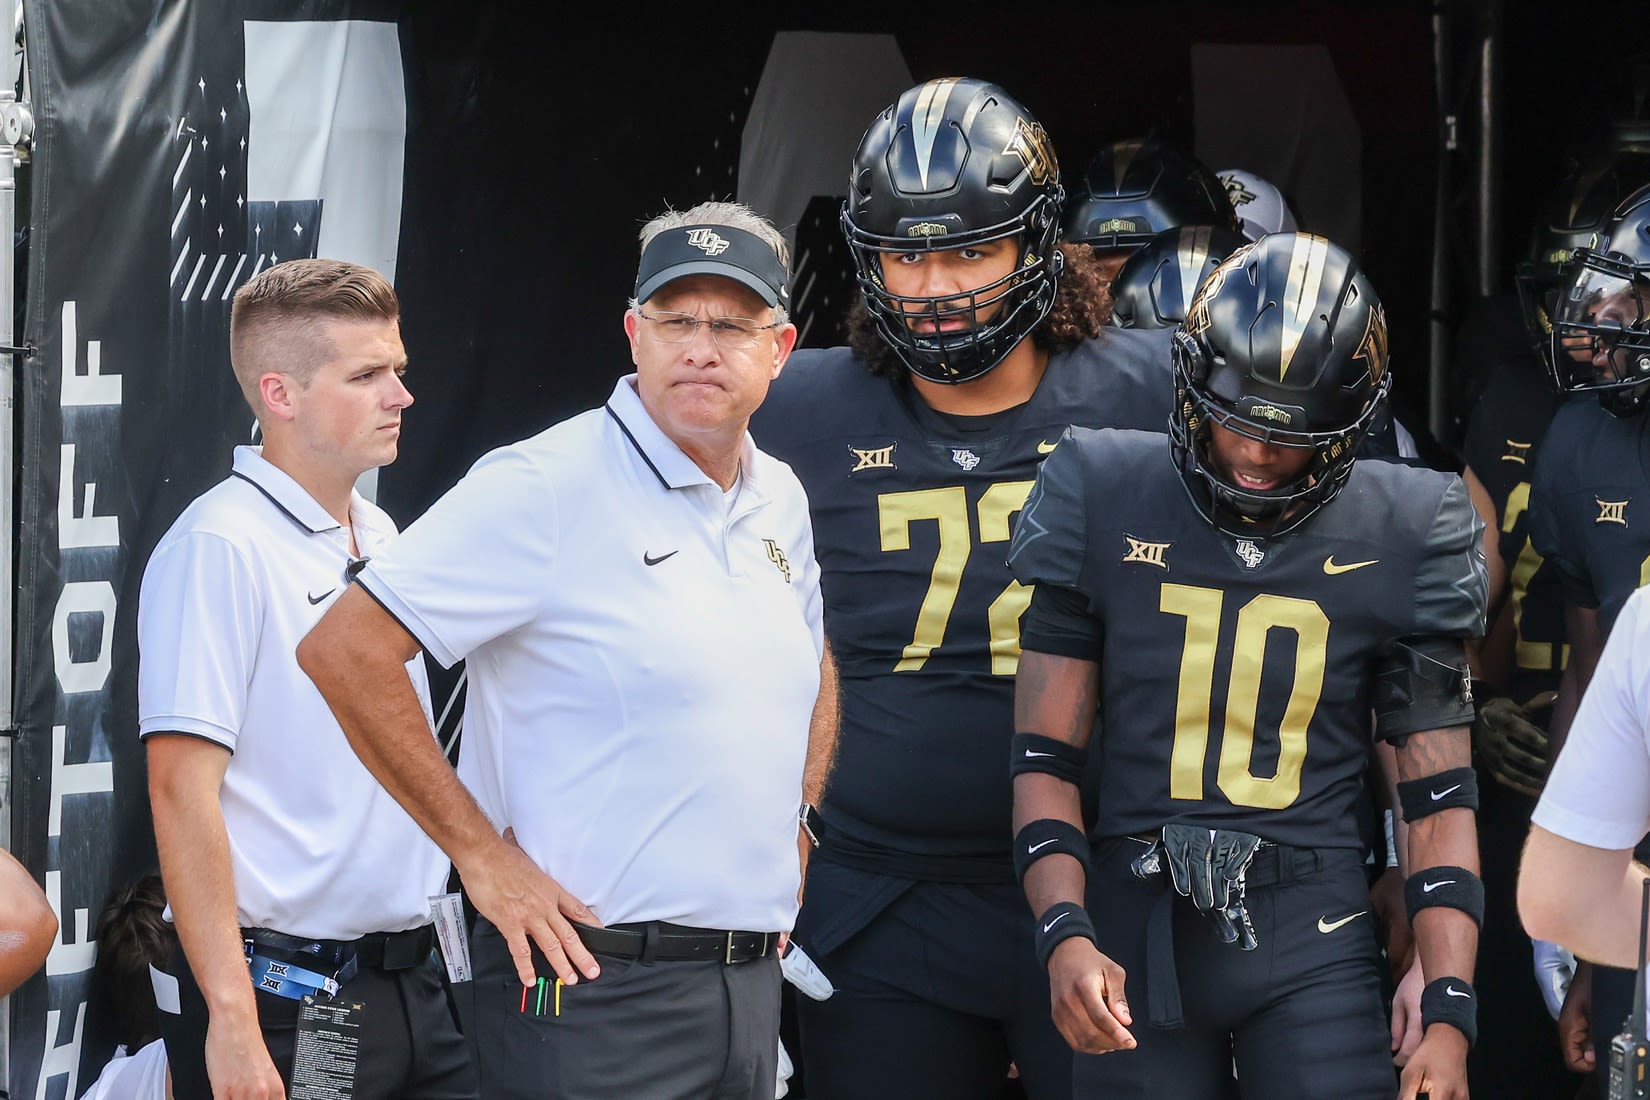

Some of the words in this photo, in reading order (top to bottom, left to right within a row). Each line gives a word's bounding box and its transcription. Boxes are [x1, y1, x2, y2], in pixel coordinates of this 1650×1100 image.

[685, 228, 730, 256] UCF
[851, 445, 896, 473] XII
[952, 449, 981, 471] UCF
[1595, 499, 1629, 526] XII
[761, 538, 791, 584] UCF
[1122, 536, 1171, 569] XII
[1236, 539, 1265, 568] UCF
[1160, 583, 1331, 810] 10
